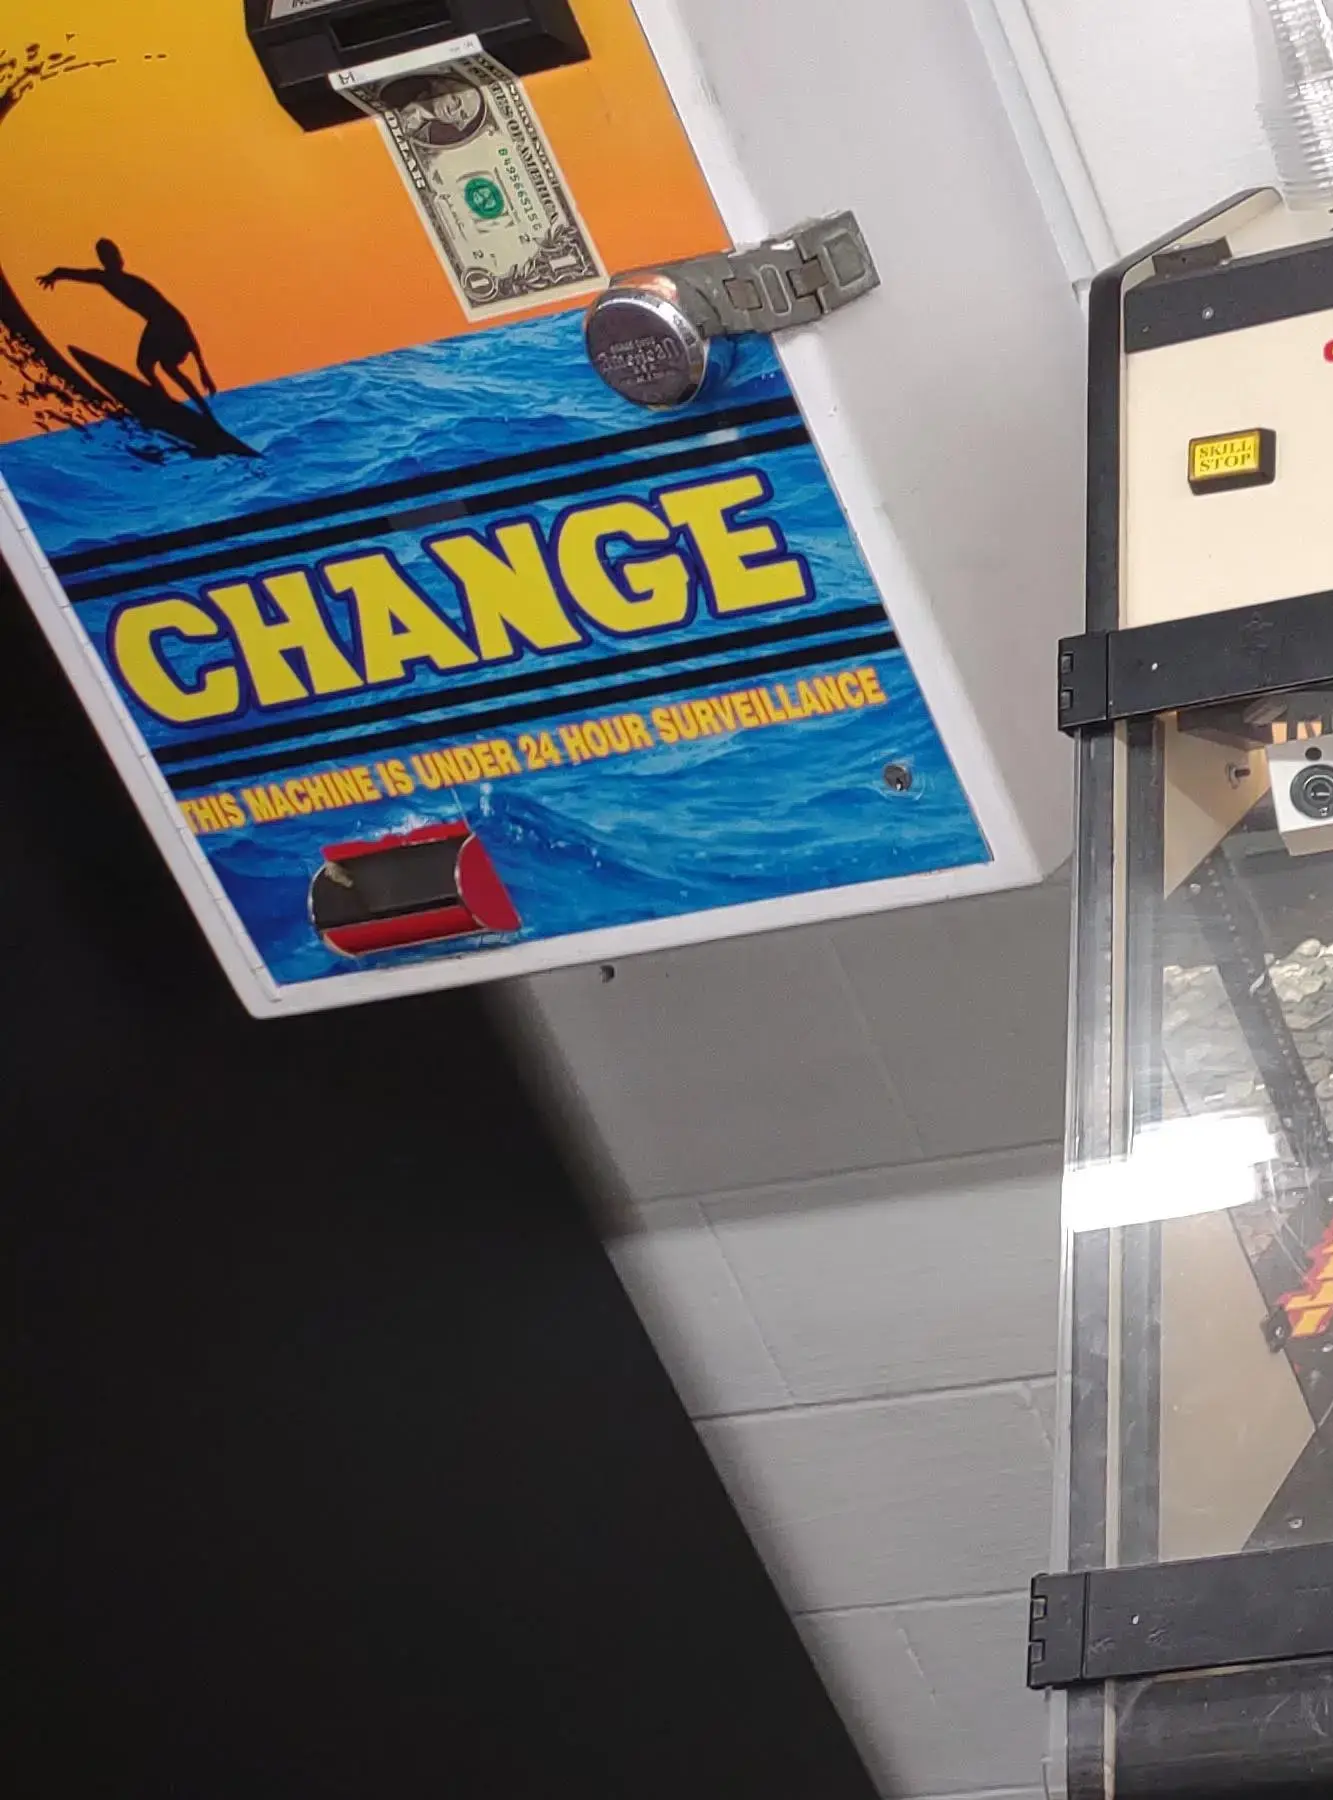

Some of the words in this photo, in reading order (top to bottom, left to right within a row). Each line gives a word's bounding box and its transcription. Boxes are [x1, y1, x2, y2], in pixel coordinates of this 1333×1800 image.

[1200, 440, 1252, 458] SKILL
[1200, 453, 1251, 472] STOP
[110, 472, 811, 724] CHANGE
[177, 791, 246, 834] THIS
[239, 765, 381, 824] MACHINE
[375, 759, 414, 797] IS
[411, 739, 521, 791] UNDER
[519, 731, 561, 771] 24
[559, 712, 655, 765] HOUR
[652, 667, 888, 745] SURVEILLANCE
